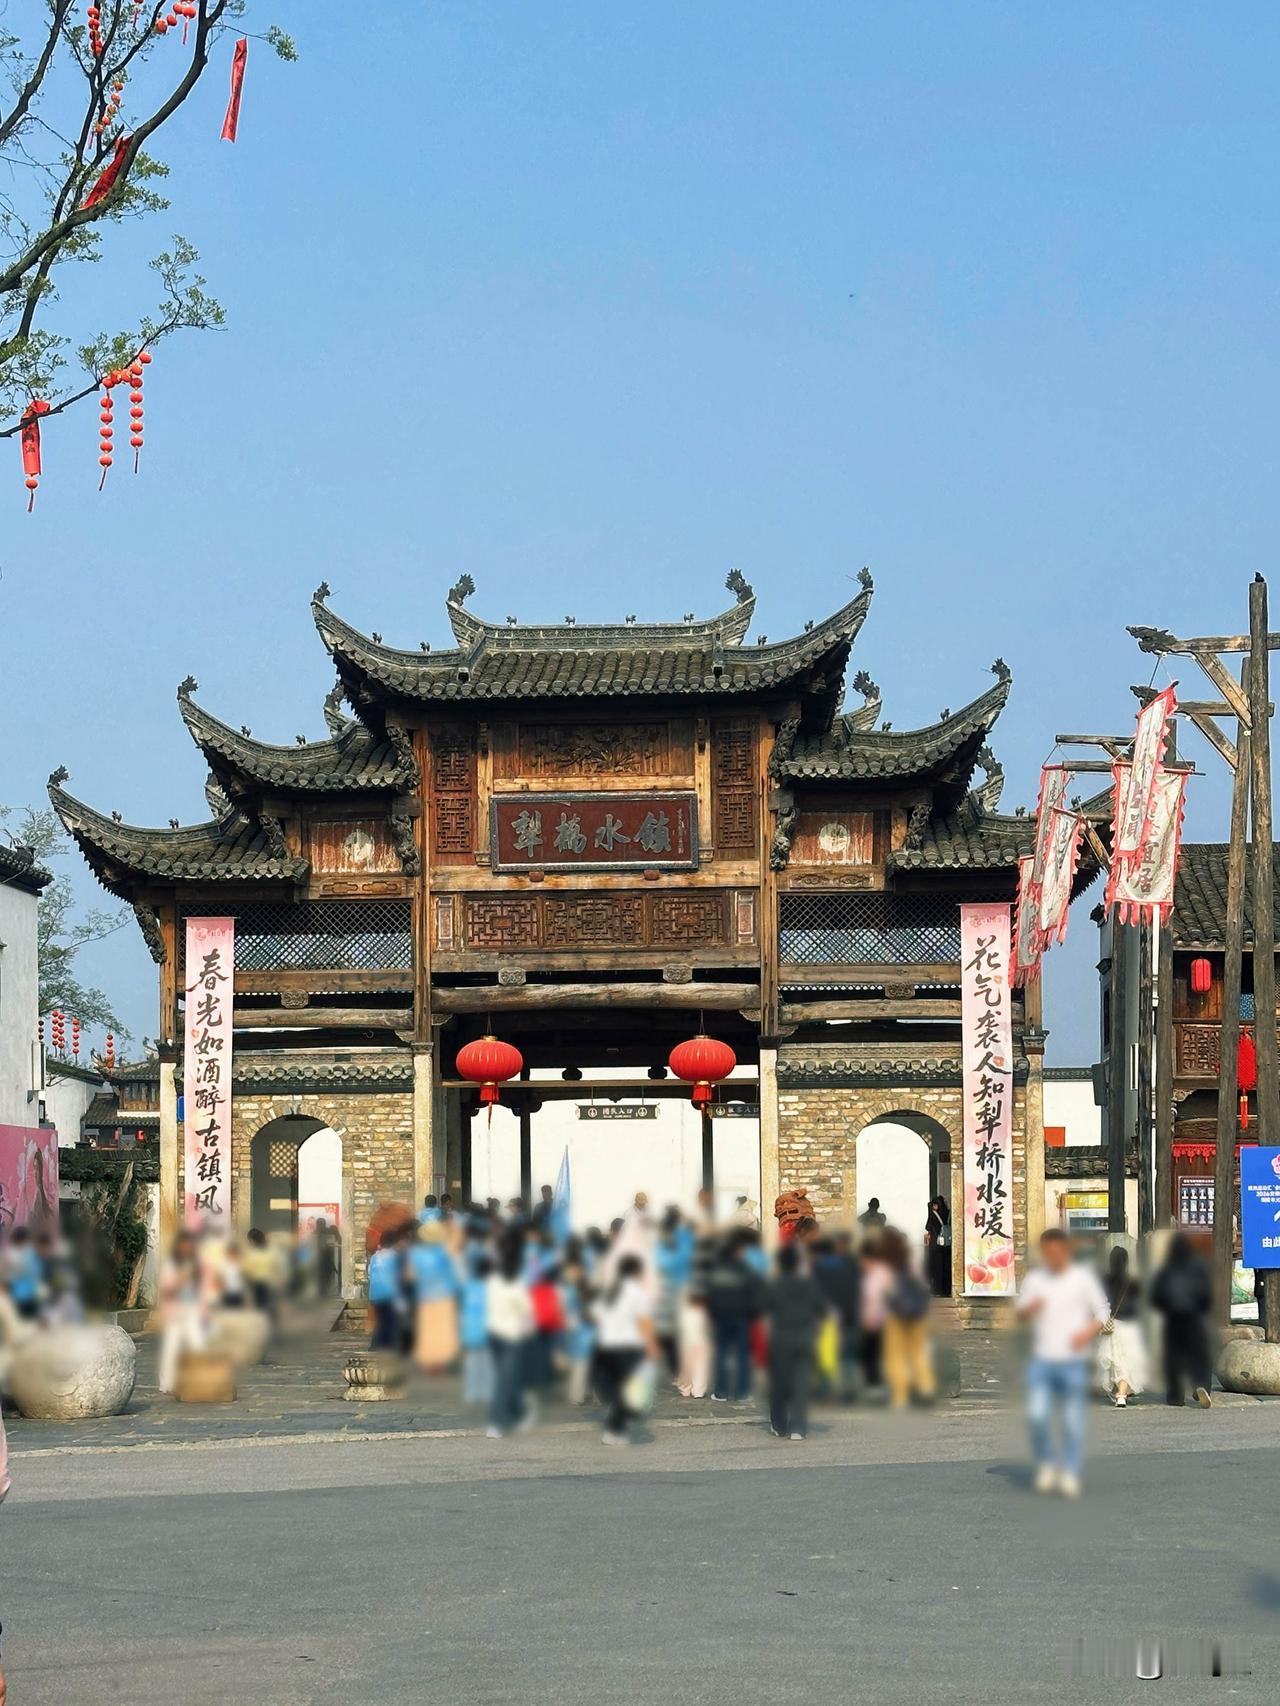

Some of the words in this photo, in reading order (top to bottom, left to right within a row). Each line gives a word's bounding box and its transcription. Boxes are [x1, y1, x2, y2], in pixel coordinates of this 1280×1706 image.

[186, 948, 229, 1214] 春光如酒醉古镇风
[965, 935, 1012, 1239] 花气袭人知犁桥水暖
